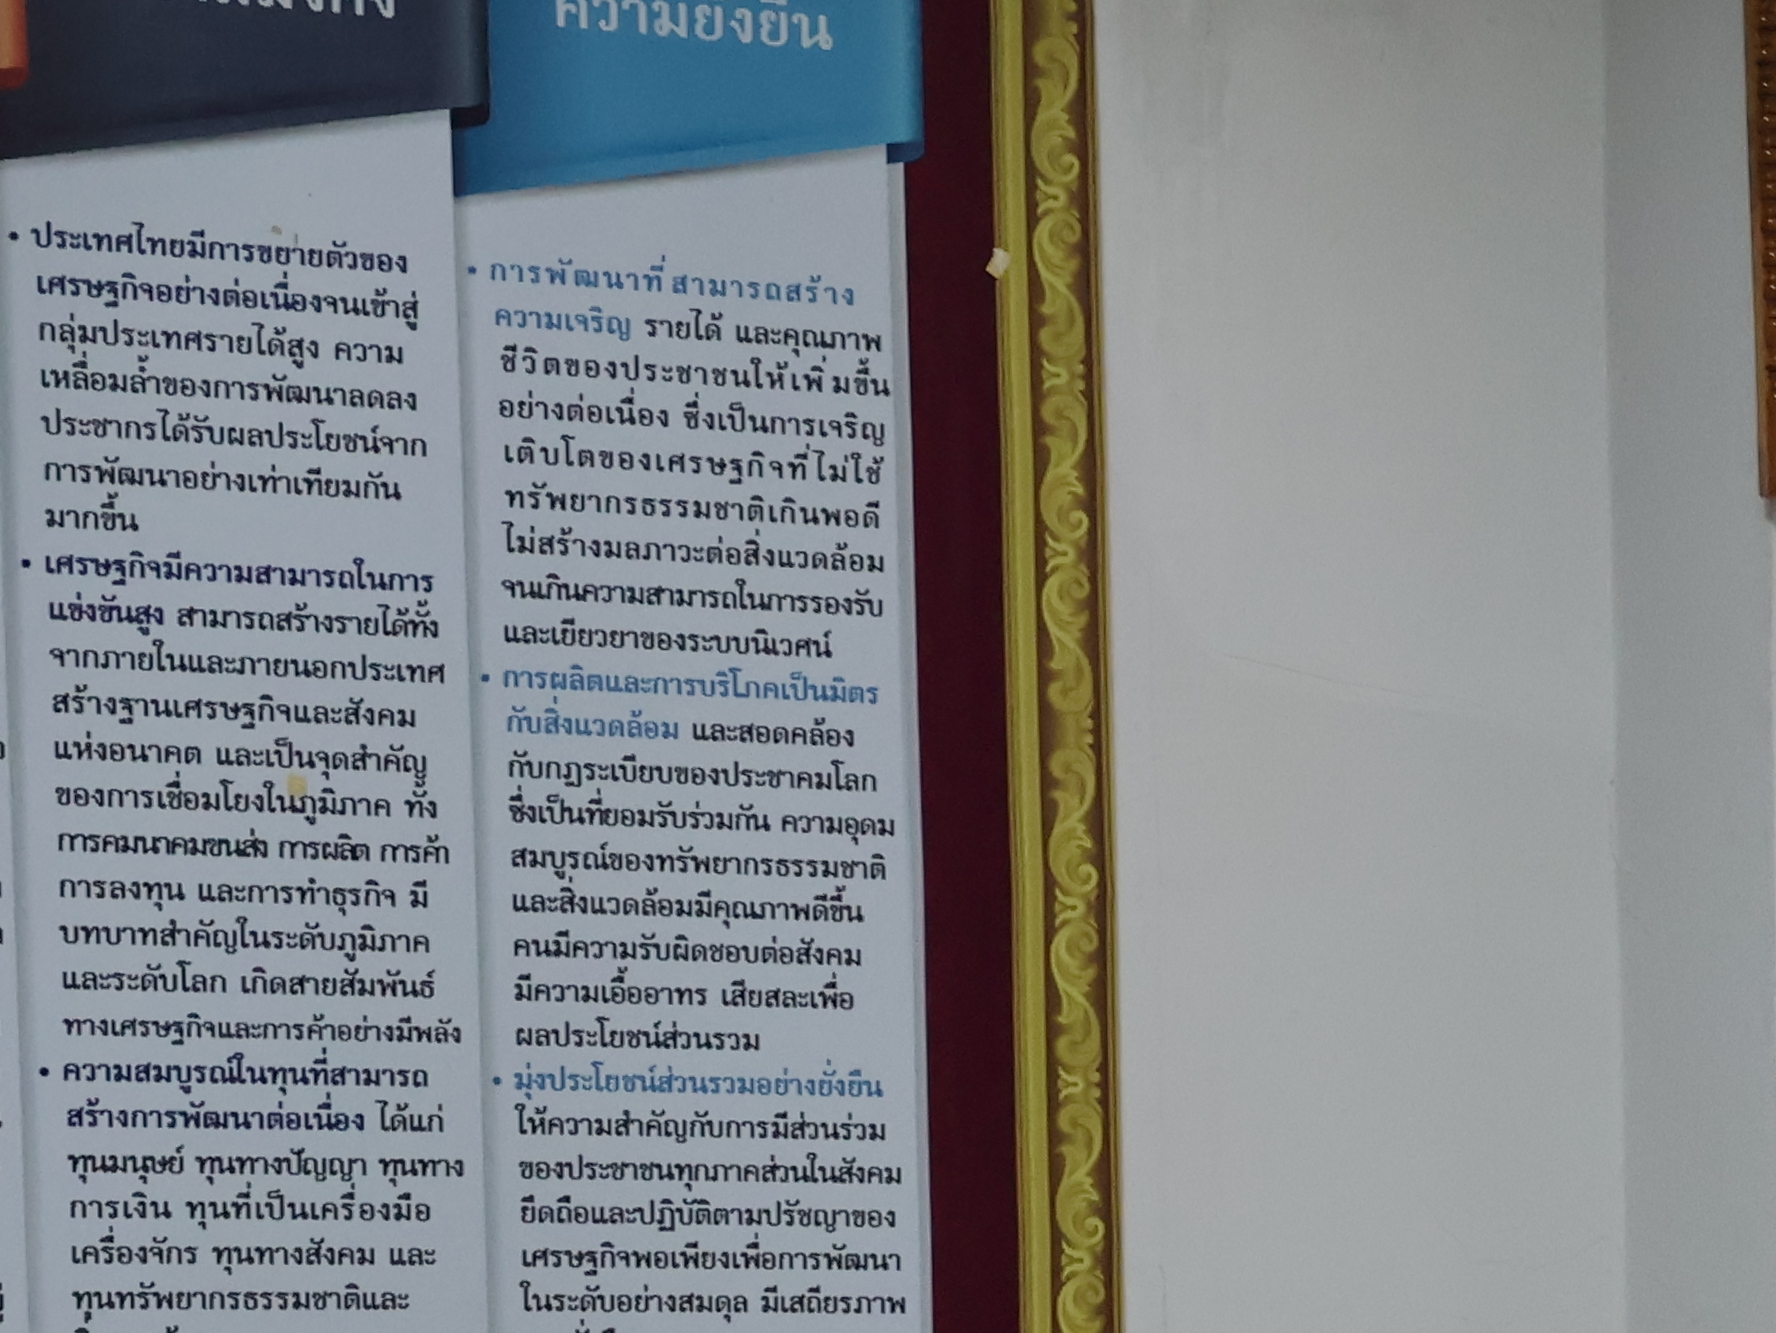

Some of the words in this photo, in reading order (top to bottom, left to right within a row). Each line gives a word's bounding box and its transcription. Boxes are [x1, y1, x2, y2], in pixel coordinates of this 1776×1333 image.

[555, 0, 835, 52] ความยงยน
[38, 312, 321, 369] กลุ่มประเทศรายได้สูง
[334, 340, 404, 365] ความ
[494, 305, 632, 342] ความเจริญ
[644, 308, 723, 342] รายได้
[735, 325, 882, 358] และคุณภาพ
[498, 387, 670, 429] อย่างต่อเนื่อง
[41, 406, 428, 458] ประชากรได้รับผลประโยชน์จาก
[44, 454, 402, 501] การพัฒนาอย่างเท่าเทียมกัน
[45, 491, 140, 533] มากขึ้น
[504, 480, 881, 531] ทรัพยากรธรรมชาติเกินพอดี
[501, 520, 886, 575] ไม่สร้างมลภาวะต่อสิ่งแวดล้อม
[44, 550, 435, 593] เศรษฐกิจมีความสามารถในการ
[48, 591, 164, 636] แข่งขันสูง
[177, 599, 439, 640] สามารถสร้างรายได้ทั้ง
[500, 572, 884, 619] จนเกินความสามารถในการรองรับ
[48, 638, 446, 685] จากภายในและภายนอกประเทศ
[52, 683, 416, 730] สร้างฐานเศรษฐกิจและสังคม
[502, 663, 880, 706] การผลิตและการบริโภคเป็นมิตร
[505, 695, 680, 741] กับสิ่งแวดล้อม
[691, 717, 856, 749] และสอดคล้อง
[54, 731, 202, 765] แห่งอนาคต
[215, 736, 428, 781] และเป็นจุดสำคัญ
[404, 782, 438, 820] ทั้ง
[58, 829, 269, 859] การคมนาคมขนส่ง
[278, 832, 371, 863] การผลิต
[380, 834, 450, 865] การค้า
[781, 813, 896, 848] ความอุดม
[510, 841, 887, 882] สมบูรณ์ของทรัพยากรธรรมชาติ
[58, 877, 185, 912] การลงทุน
[197, 879, 397, 918] และการทำธุรกิจ
[409, 880, 430, 910] มี
[512, 876, 866, 929] และสิ่งแวดล้อมมีคุณภาพดีขึ้น
[58, 916, 431, 963] บทบาทสำคัญในระดับภูมิภาค
[513, 930, 863, 968] คนมีความรับผิดชอบต่อสังคม
[61, 960, 228, 994] และระดับโลก
[240, 965, 437, 1000] เกิดสายสัมพันธ์
[513, 965, 709, 1005] มีความเอื้ออาทร
[720, 970, 855, 1012] เสียสละเพื่อ
[63, 1013, 463, 1047] ทางเศรษฐกิจและการค้าอย่างมีพลัง
[514, 1015, 761, 1053] ผลประโยชน์ส่วนรวม
[63, 1047, 430, 1095] ความสมบูรณ์ในทุนที่สามารถ
[513, 1059, 884, 1101] มุ่งประโยชน์ส่วนรวมอย่างยั่งยืน
[66, 1091, 366, 1132] สร้างการพัฒนาต่อเนื่อง
[376, 1099, 446, 1134] ได้แก่
[513, 1102, 887, 1143] ให้ความสำคัญกับการมีส่วนร่วม
[66, 1145, 185, 1184] ทุนมนุษย์
[195, 1148, 368, 1186] ทุนทางปัญญา
[379, 1156, 465, 1187] ทุนทาง
[518, 1150, 903, 1192] ของประชาชนทุกภาคส่วนในสังคม
[69, 1191, 173, 1221] การเงิน
[185, 1180, 432, 1229] ทุนที่เป็นเครื่องมือ
[70, 1226, 199, 1267] เครื่องจักร
[211, 1236, 376, 1275] ทุนทางสังคม
[390, 1246, 437, 1268] และ
[521, 1232, 902, 1277] เศรษฐกิจพอเพียงเพื่อการพัฒนา
[71, 1281, 410, 1324] ทุนทรัพยากรธรรมชาติและ
[518, 1279, 750, 1324] ในระดับอย่างสมดุล
[760, 1286, 908, 1316] มีเสถียรภาพ
